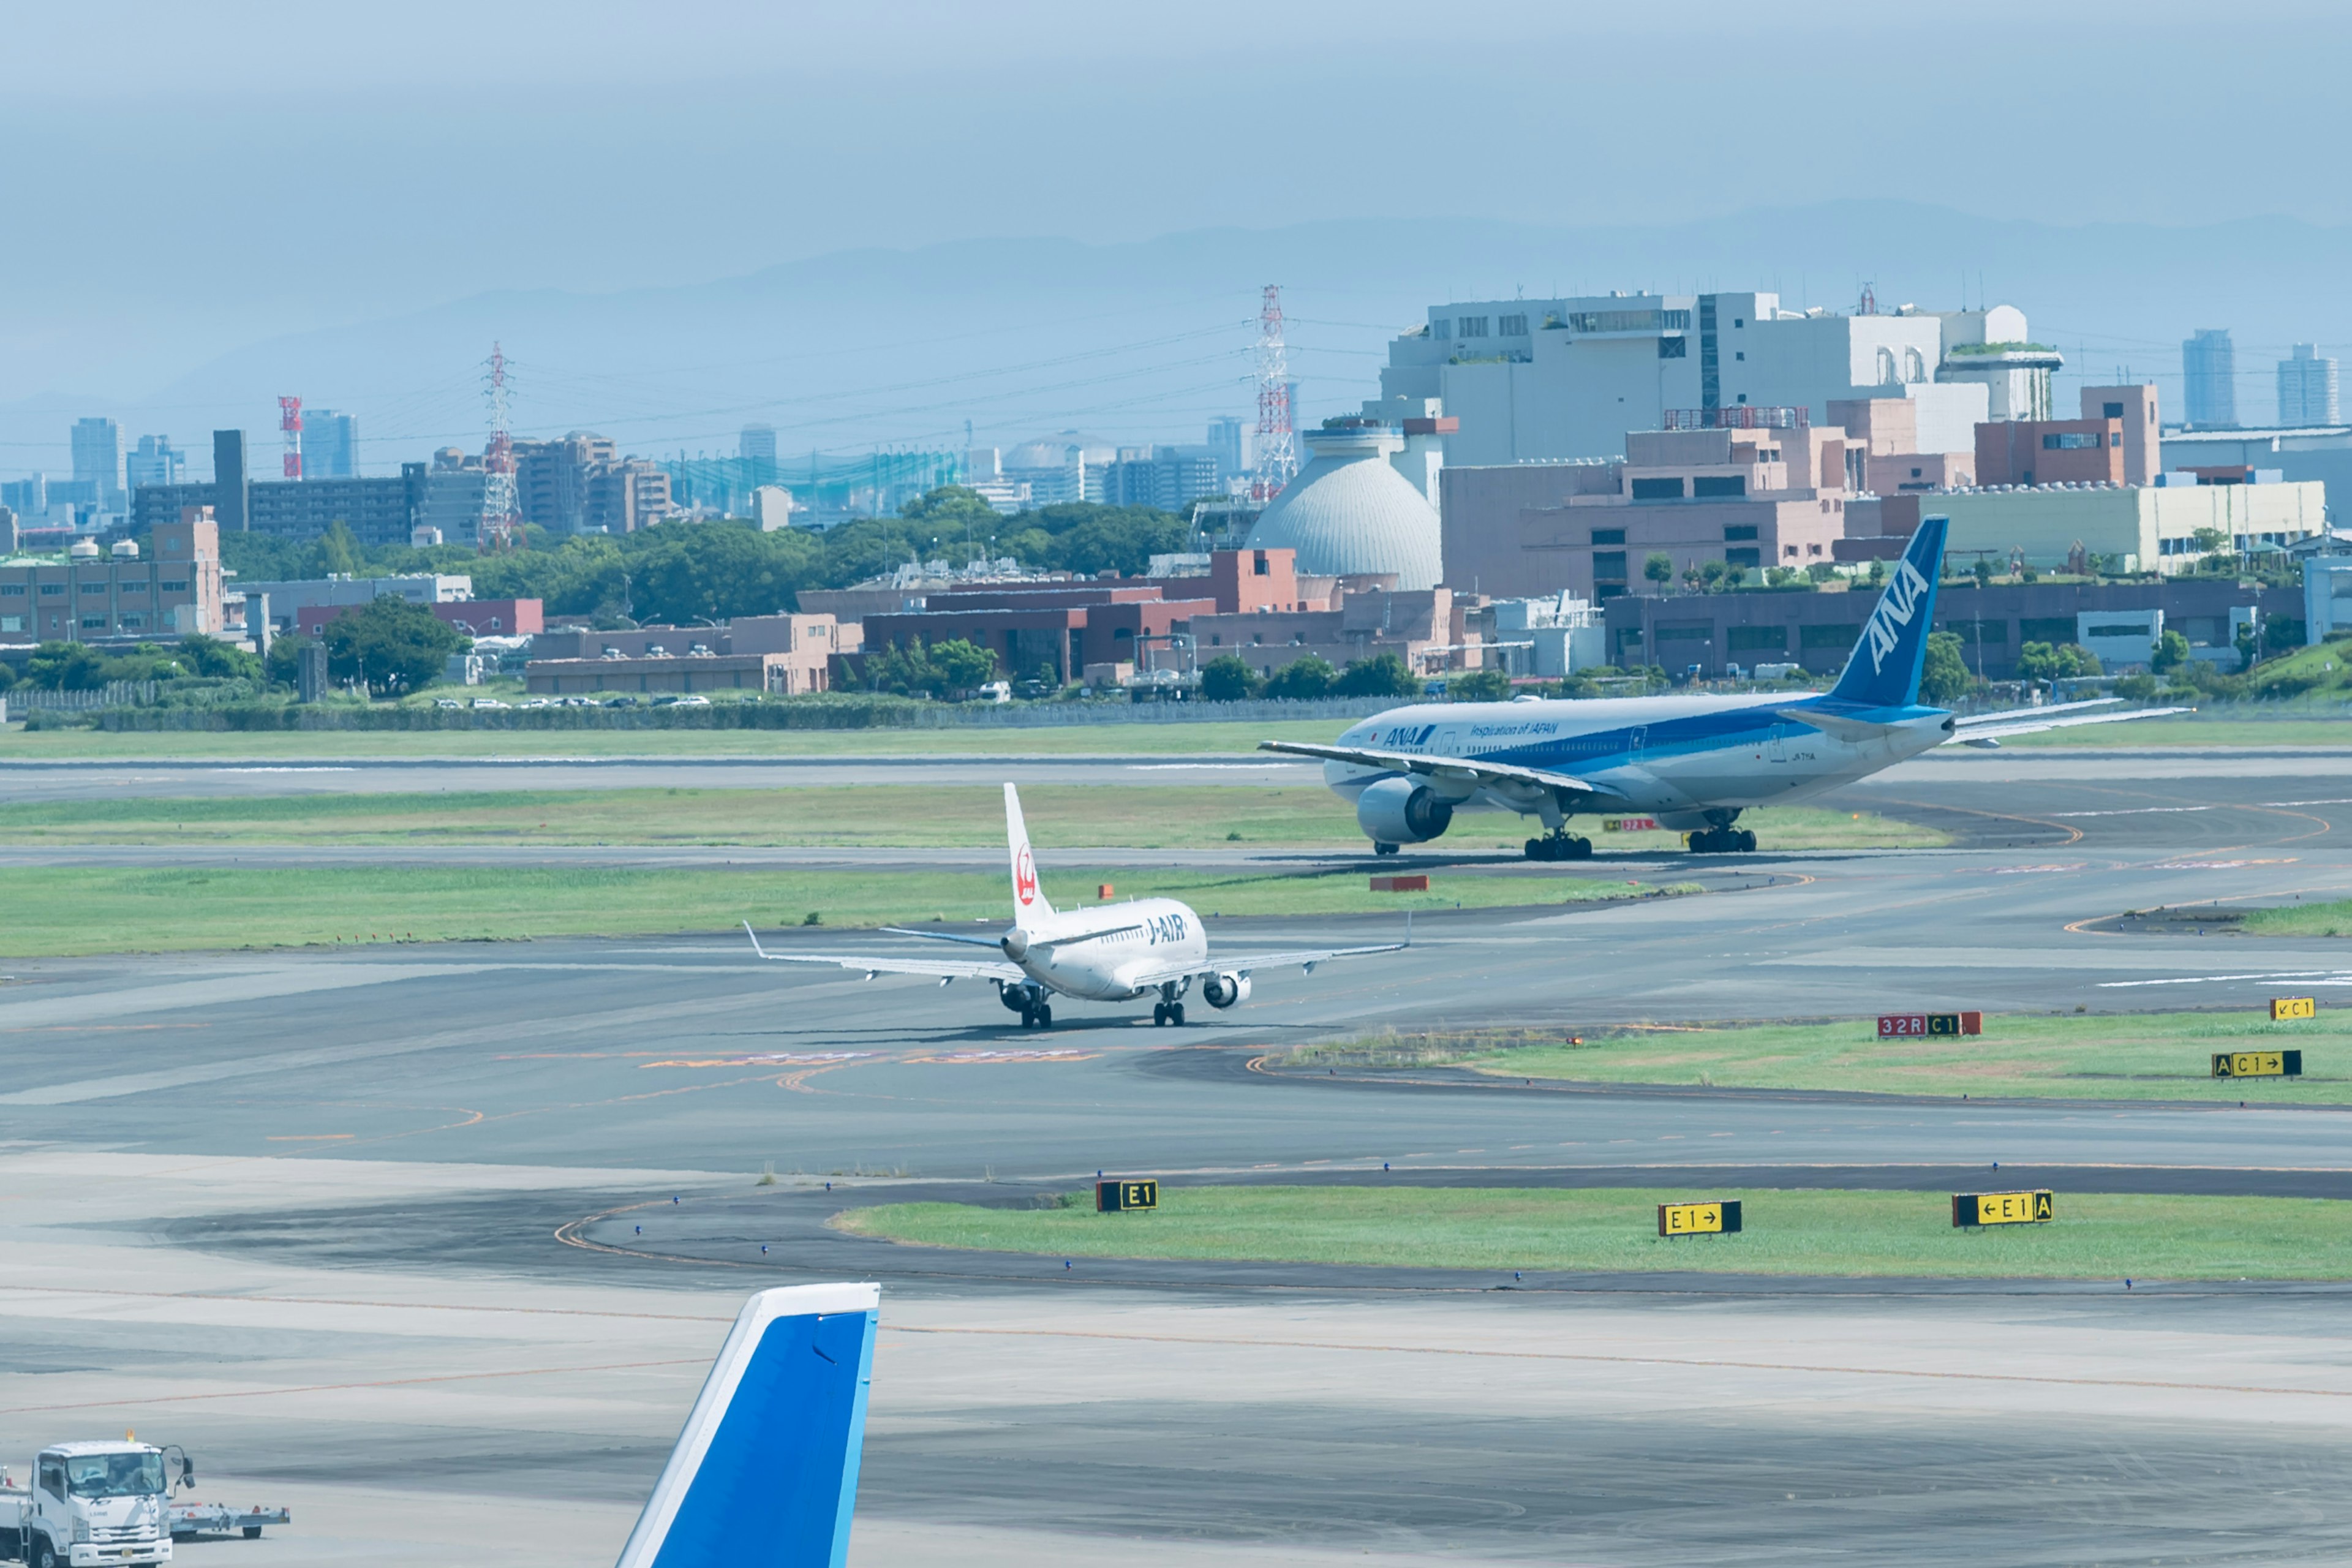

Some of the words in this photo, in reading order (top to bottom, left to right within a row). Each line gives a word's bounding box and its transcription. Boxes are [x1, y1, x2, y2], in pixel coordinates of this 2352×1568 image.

[1869, 559, 1928, 676] ANA
[1383, 727, 1419, 746] ANA
[1471, 725, 1517, 739] Inspiration
[1518, 723, 1530, 736] of
[1529, 722, 1559, 735] JAPAN
[1147, 914, 1185, 946] J-AIR
[2293, 1001, 2309, 1015] C1
[1882, 1018, 1921, 1033] 32R
[1932, 1017, 1953, 1032] C1
[2217, 1058, 2230, 1074] A
[2239, 1056, 2259, 1072] C1
[1129, 1185, 1150, 1204] E1
[2003, 1198, 2026, 1218] E1
[2037, 1196, 2051, 1216] A
[1672, 1210, 1695, 1229] E1
